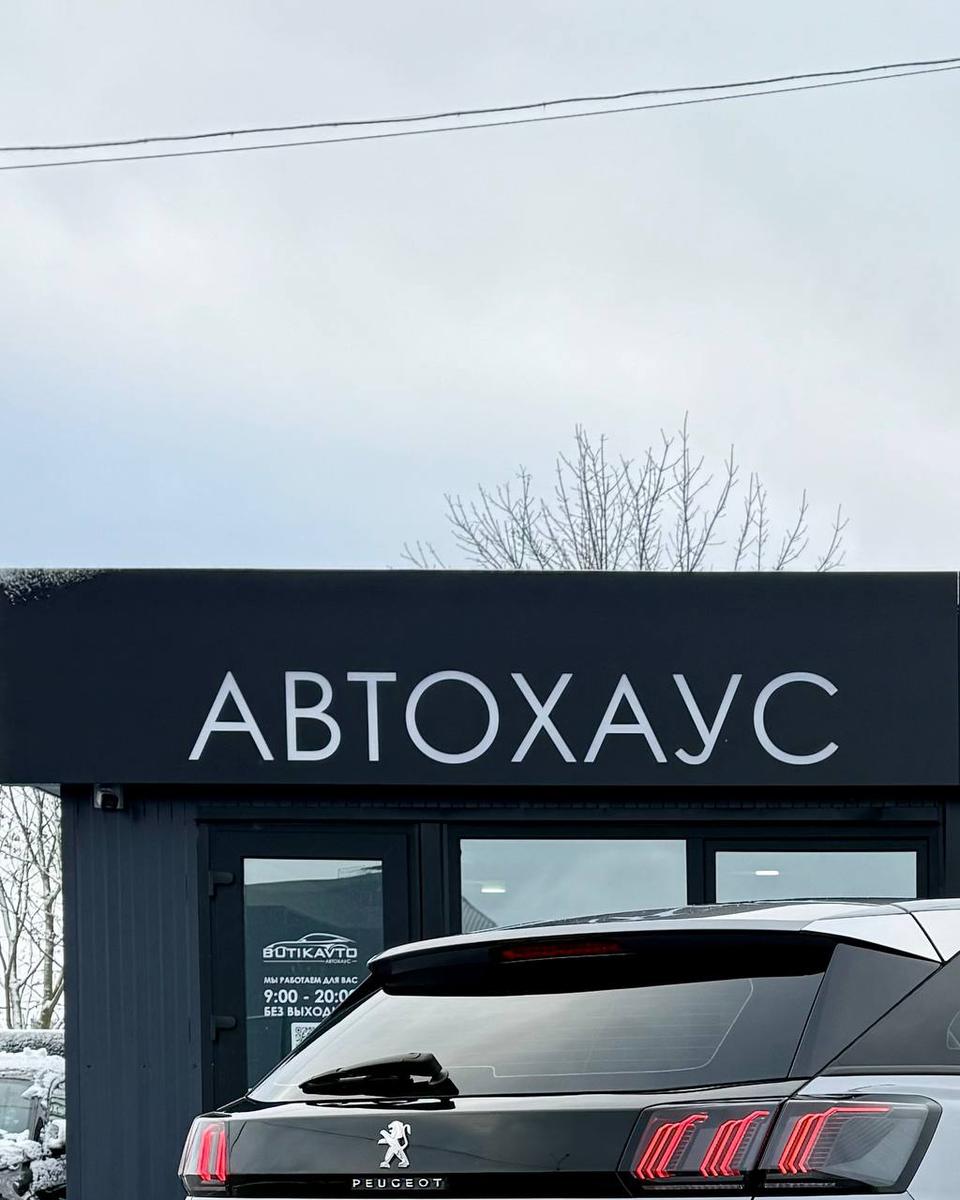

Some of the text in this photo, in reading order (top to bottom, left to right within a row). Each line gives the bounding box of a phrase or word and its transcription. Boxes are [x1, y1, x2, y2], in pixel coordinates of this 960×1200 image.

[188, 669, 839, 764] АВТОХАУС
[262, 947, 358, 959] BUTIKAVTO
[264, 976, 359, 985] МЫ РАБОТАЕМ ДЛЯ ВАС
[263, 989, 299, 1004] 9:00
[264, 1006, 336, 1018] БЕЗ ВЫХОД
[352, 1178, 443, 1188] PEUGEOT
